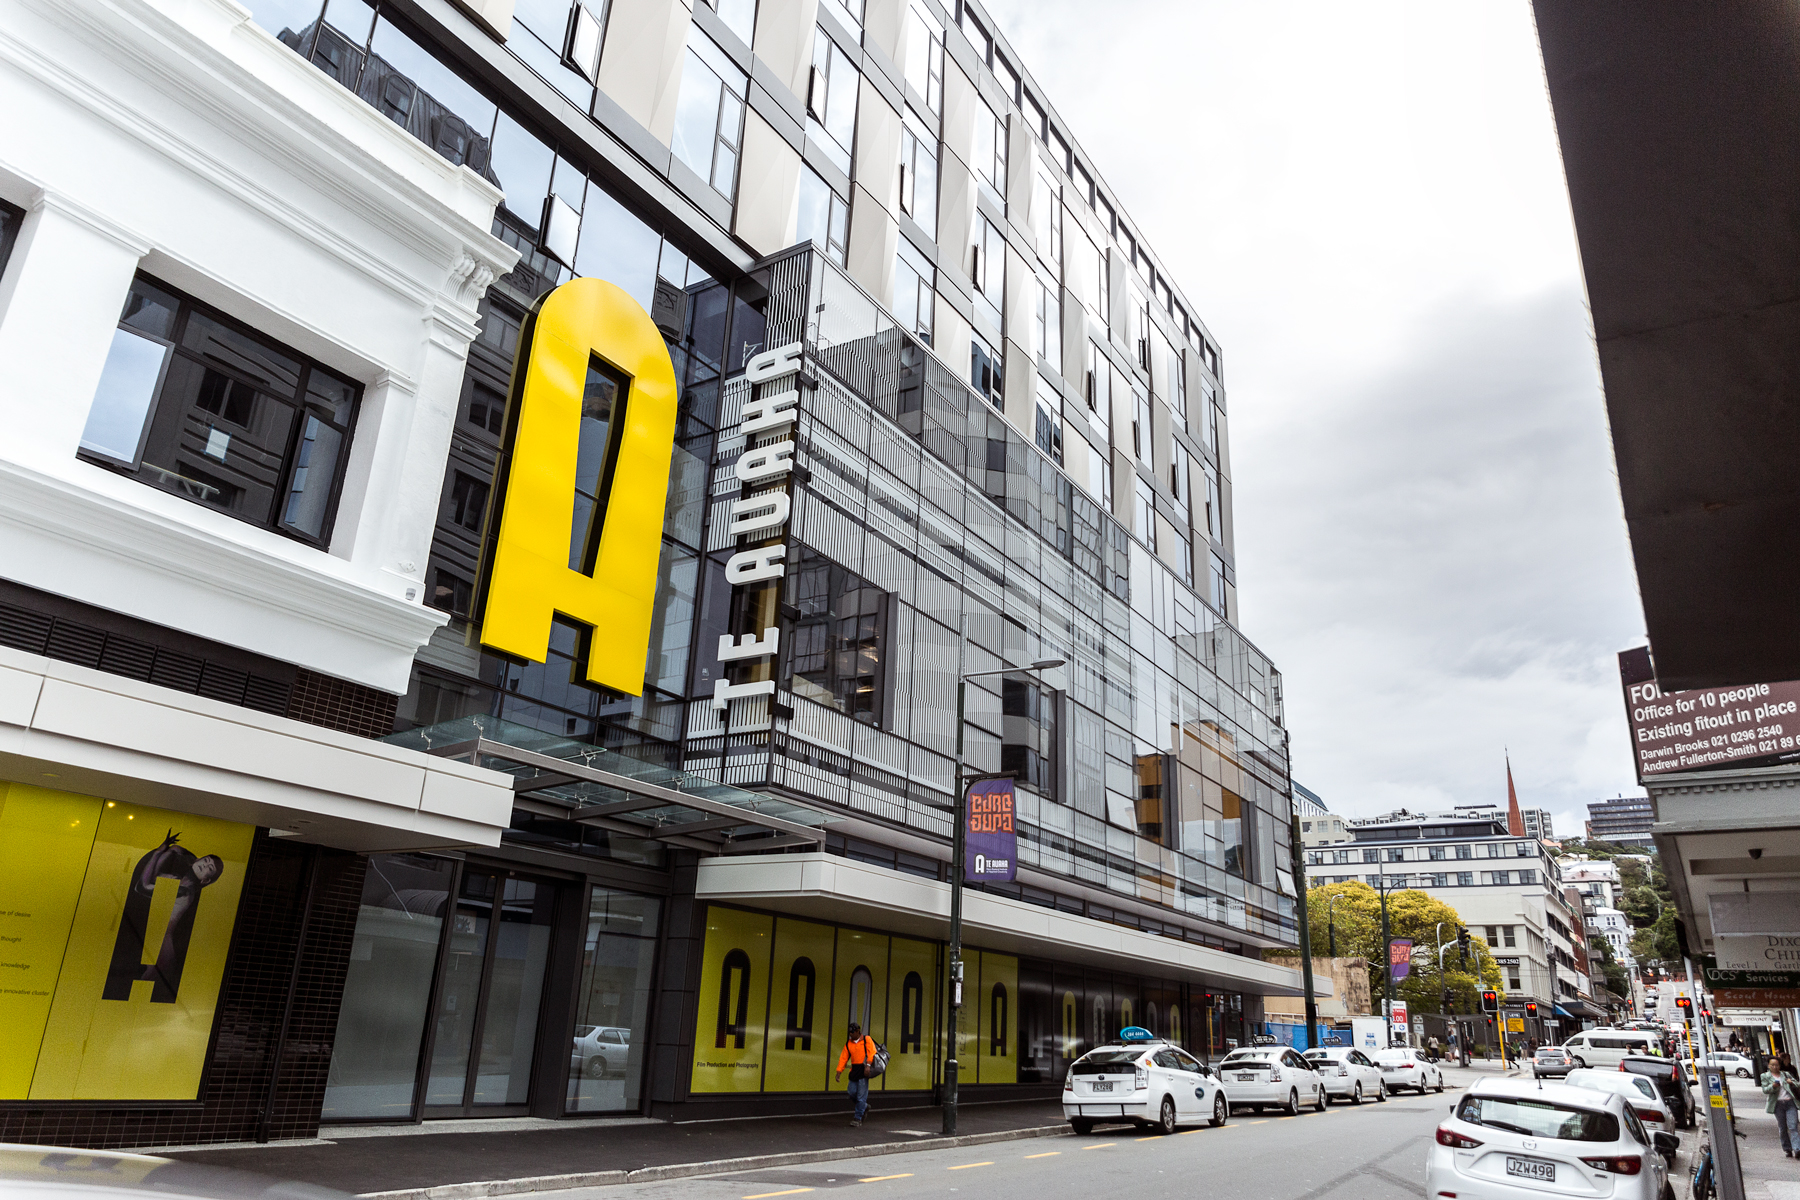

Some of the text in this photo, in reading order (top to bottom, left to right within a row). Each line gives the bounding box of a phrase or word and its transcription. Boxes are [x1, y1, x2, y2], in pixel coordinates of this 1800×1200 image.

[713, 341, 803, 710] TE AUAHA
[1634, 683, 1770, 722] Office for 10 people
[1637, 700, 1797, 742] Existing fitout in place
[1640, 724, 1783, 760] Darwin Brooks 021 0296 2540
[1643, 758, 1678, 773] Andrew
[1680, 743, 1757, 766] Fullerton-Smith
[1758, 739, 1778, 752] 021
[1780, 736, 1794, 749] 89
[1726, 961, 1750, 969] Level
[1745, 973, 1789, 982] Services
[1708, 1075, 1719, 1088] P
[1508, 1160, 1554, 1178] JZW490
